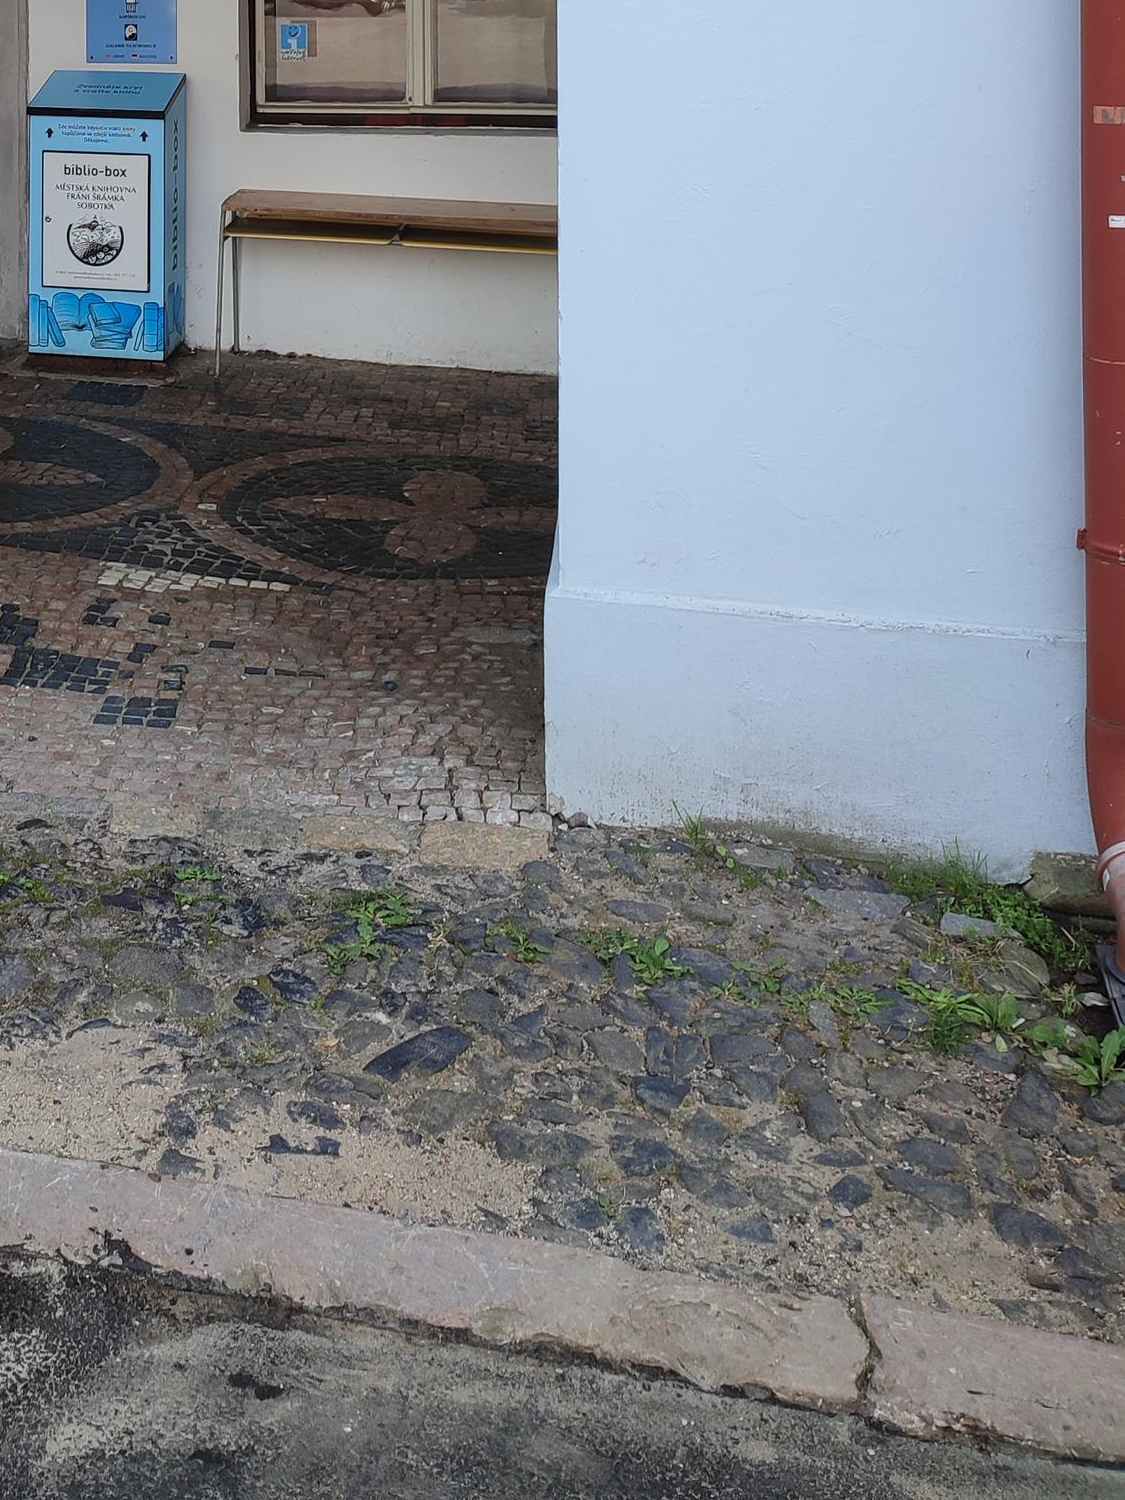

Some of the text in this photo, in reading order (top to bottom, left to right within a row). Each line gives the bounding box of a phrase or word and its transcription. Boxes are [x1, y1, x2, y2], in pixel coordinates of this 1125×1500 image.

[64, 164, 127, 177] biblio-box
[55, 183, 137, 194] MĚSTSKÁ KNIHOVNA
[66, 192, 125, 202] FRÁNI ŠRÁMKA
[76, 202, 115, 210] SOBOTKA
